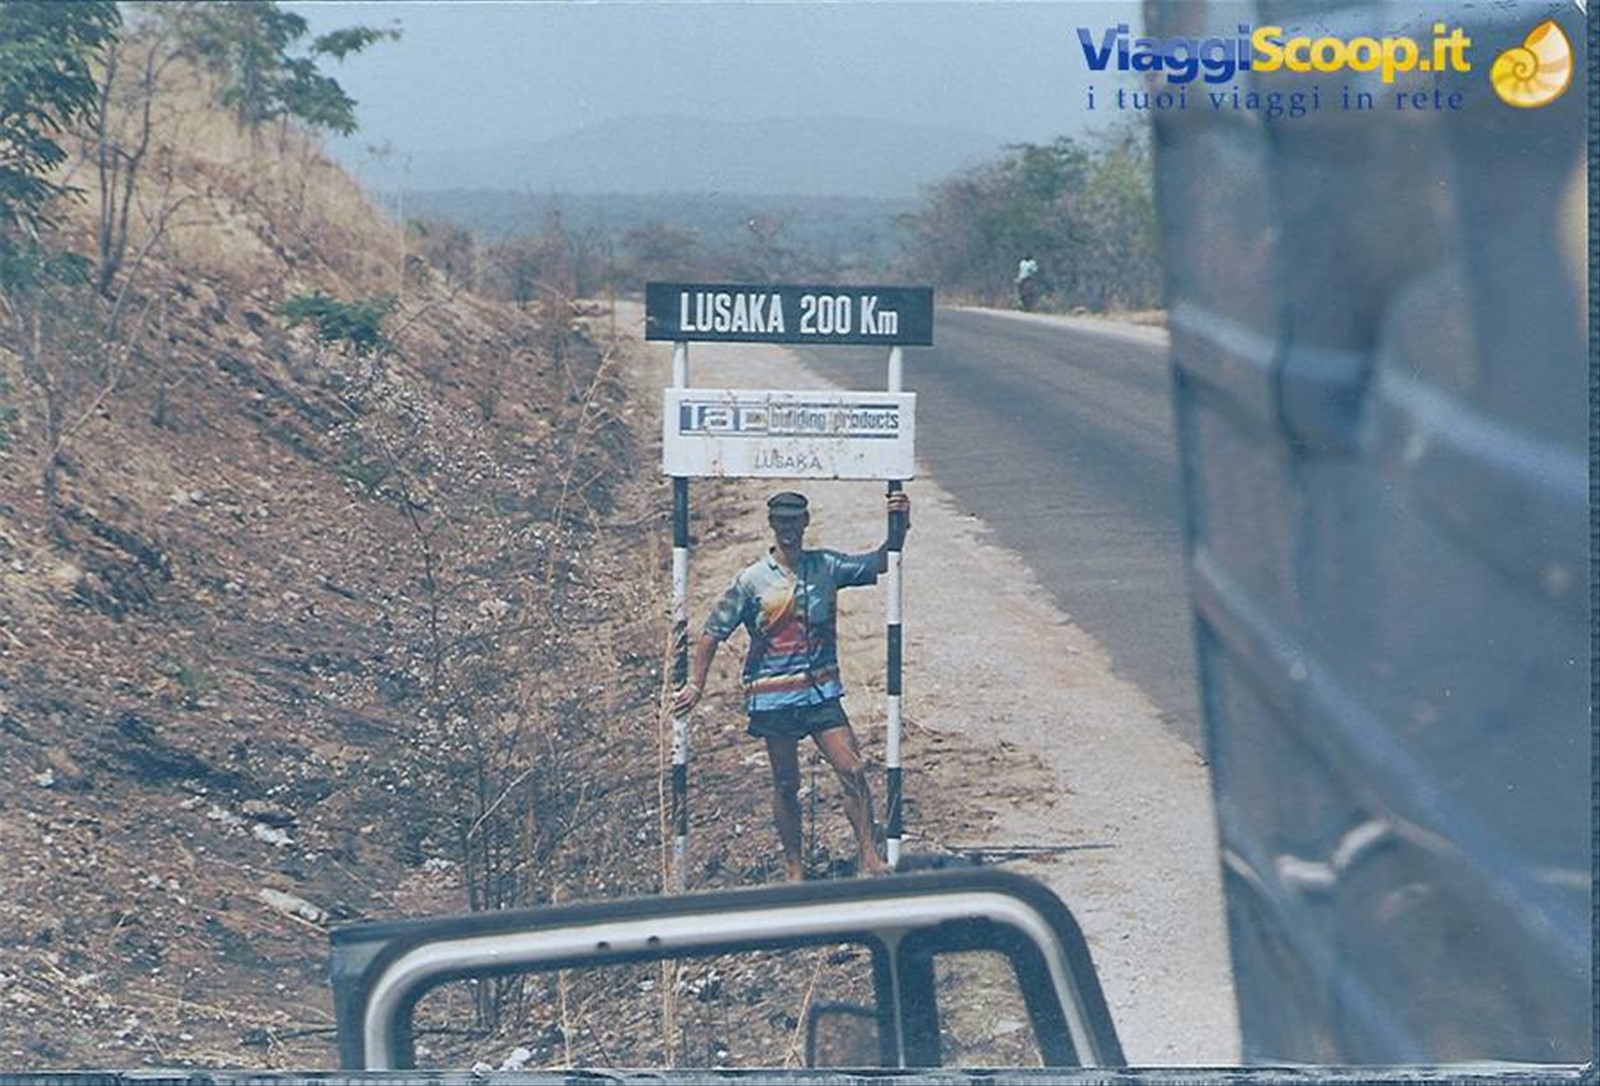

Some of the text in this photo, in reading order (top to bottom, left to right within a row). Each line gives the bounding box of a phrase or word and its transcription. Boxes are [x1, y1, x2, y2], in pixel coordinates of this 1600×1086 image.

[680, 292, 899, 335] LUSAKA 200 Km
[754, 454, 822, 470] LUSAKA
